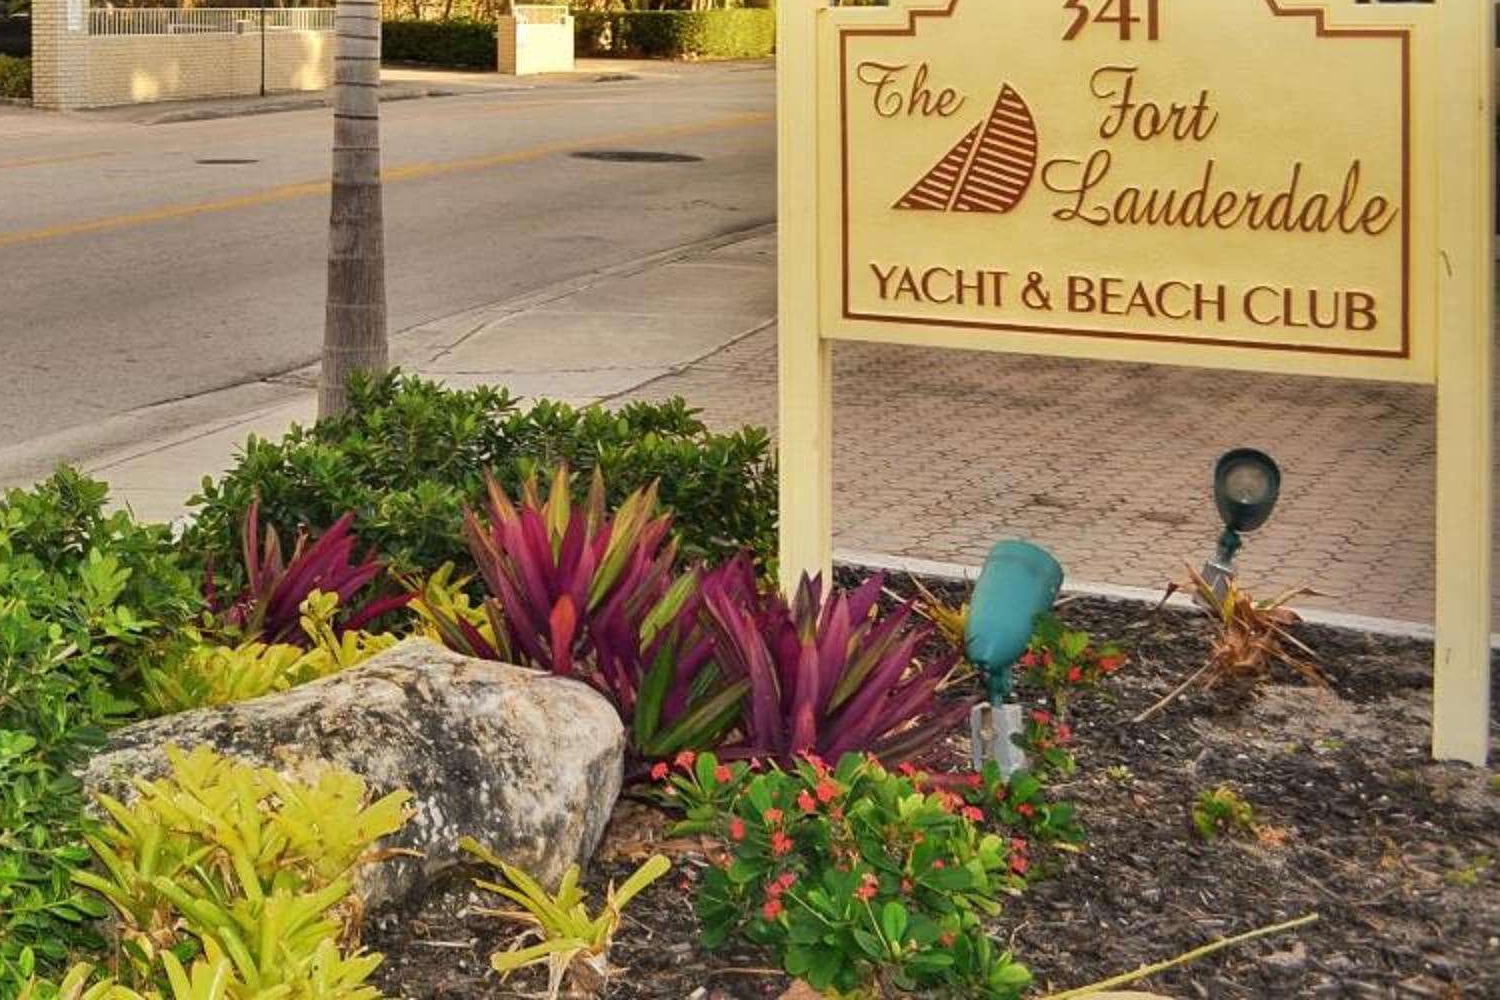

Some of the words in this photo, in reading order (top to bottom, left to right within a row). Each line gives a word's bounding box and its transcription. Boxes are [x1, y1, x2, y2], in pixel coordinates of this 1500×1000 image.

[856, 61, 967, 119] The
[1089, 65, 1220, 142] Fort
[1040, 149, 1398, 237] Lauderdale
[868, 263, 1010, 309] YACHT
[1020, 271, 1054, 312] &
[1066, 275, 1226, 323] BEACH
[1242, 285, 1380, 333] CLUB
